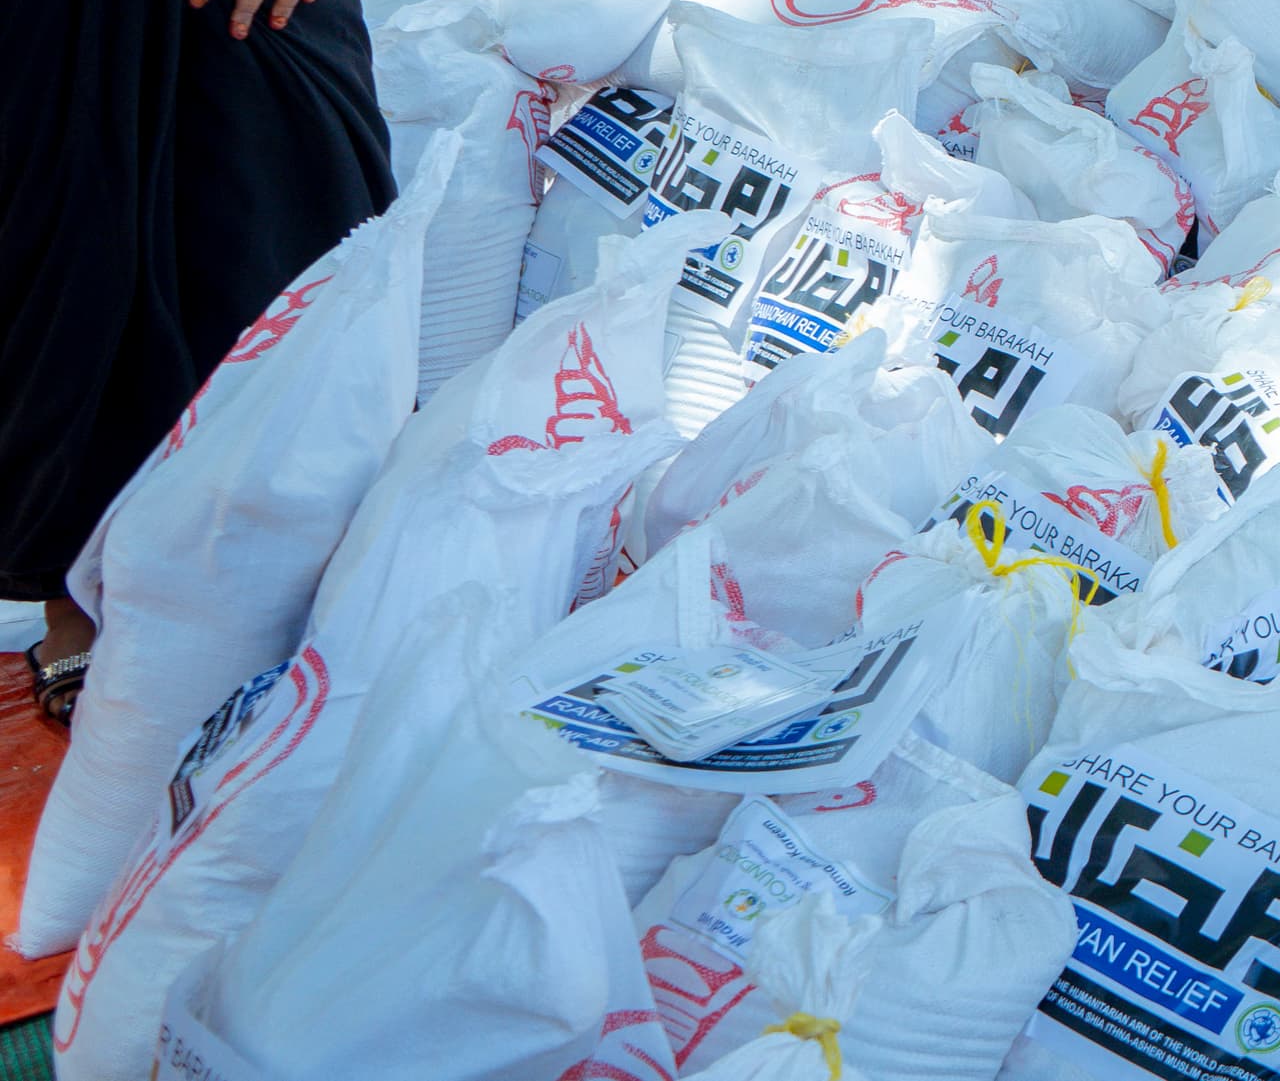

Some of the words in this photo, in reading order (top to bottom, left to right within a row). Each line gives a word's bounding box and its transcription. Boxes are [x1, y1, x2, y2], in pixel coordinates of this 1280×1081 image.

[592, 118, 636, 152] RELIEF
[697, 121, 732, 152] YOUR
[730, 140, 799, 183] BARAKAH
[855, 234, 904, 265] BARAKAH
[975, 321, 1054, 367] BARAKAH
[1009, 500, 1059, 549] YOUR
[1157, 782, 1237, 838] YOUR
[761, 819, 801, 858] Kareem
[1123, 949, 1228, 1014] RELIEF
[1056, 978, 1071, 994] HE
[1070, 982, 1131, 1026] HUMANITARIAN
[1130, 1017, 1151, 1037] ARM
[1150, 1028, 1164, 1043] OF
[1164, 1035, 1184, 1054] THE
[1183, 1042, 1219, 1072] WORLD
[1057, 994, 1086, 1019] KHOJA
[1086, 1012, 1105, 1032] SHIA
[1104, 1022, 1166, 1062] ITHNA-ASHERI
[1165, 1053, 1201, 1080] MUSLIM
